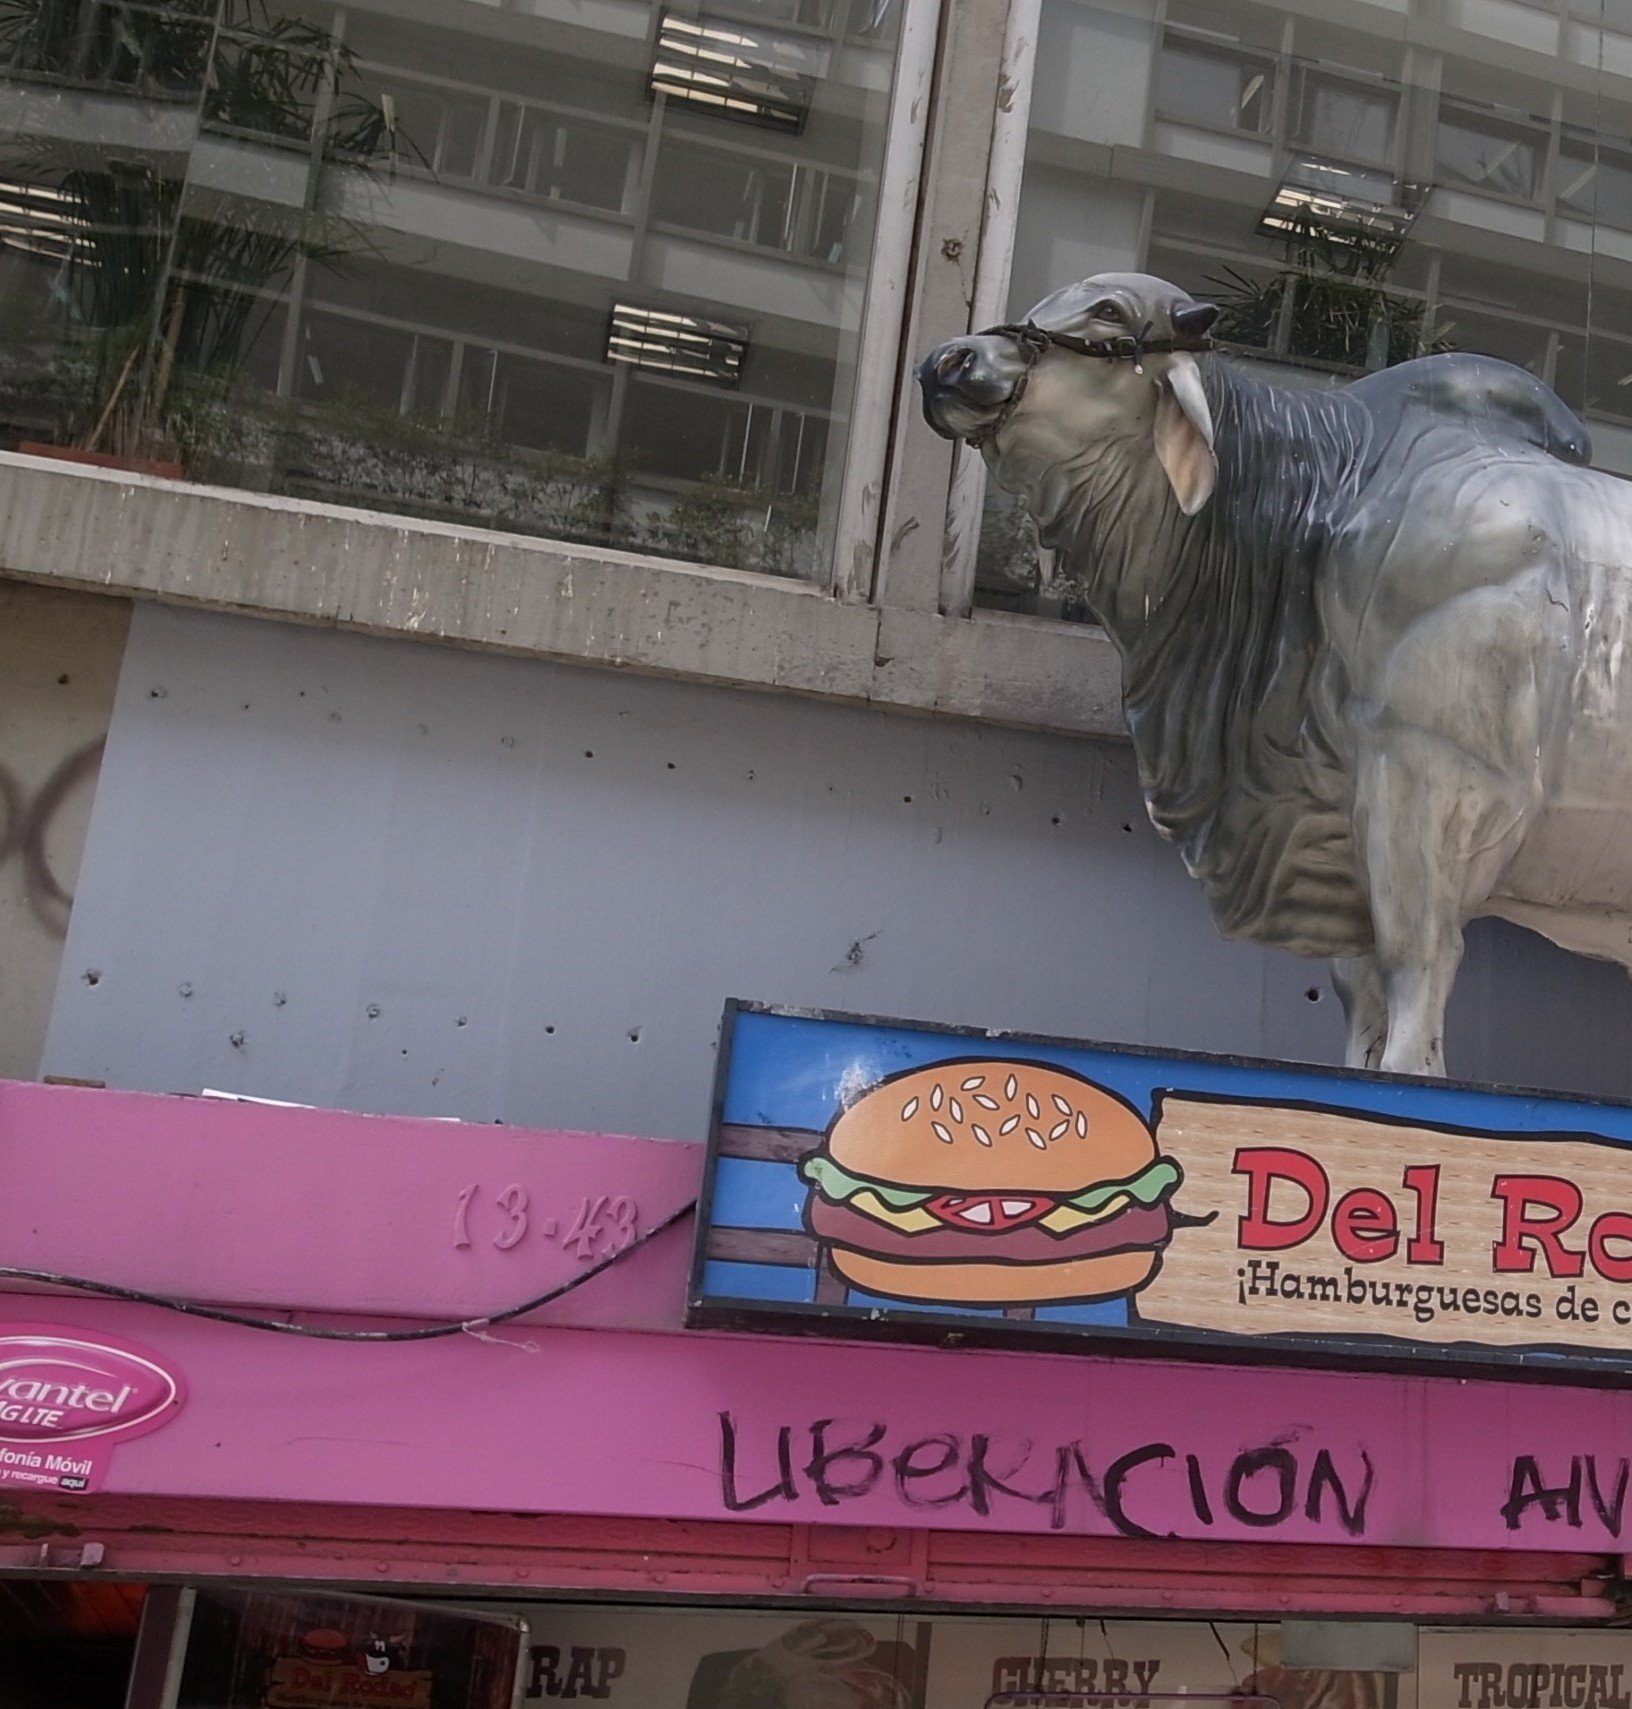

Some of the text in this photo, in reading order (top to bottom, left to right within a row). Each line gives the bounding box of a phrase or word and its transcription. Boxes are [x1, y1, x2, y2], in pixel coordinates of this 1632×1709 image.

[1231, 1146, 1446, 1266] Del
[1236, 1258, 1544, 1324] ¡Hamburguesas
[1556, 1285, 1600, 1323] de
[11, 1470, 59, 1485] recargue
[45, 1455, 93, 1476] Móvil
[526, 1645, 627, 1699] RAP
[992, 1656, 1161, 1709] CHERRY
[1453, 1662, 1631, 1709] TROPICAL
